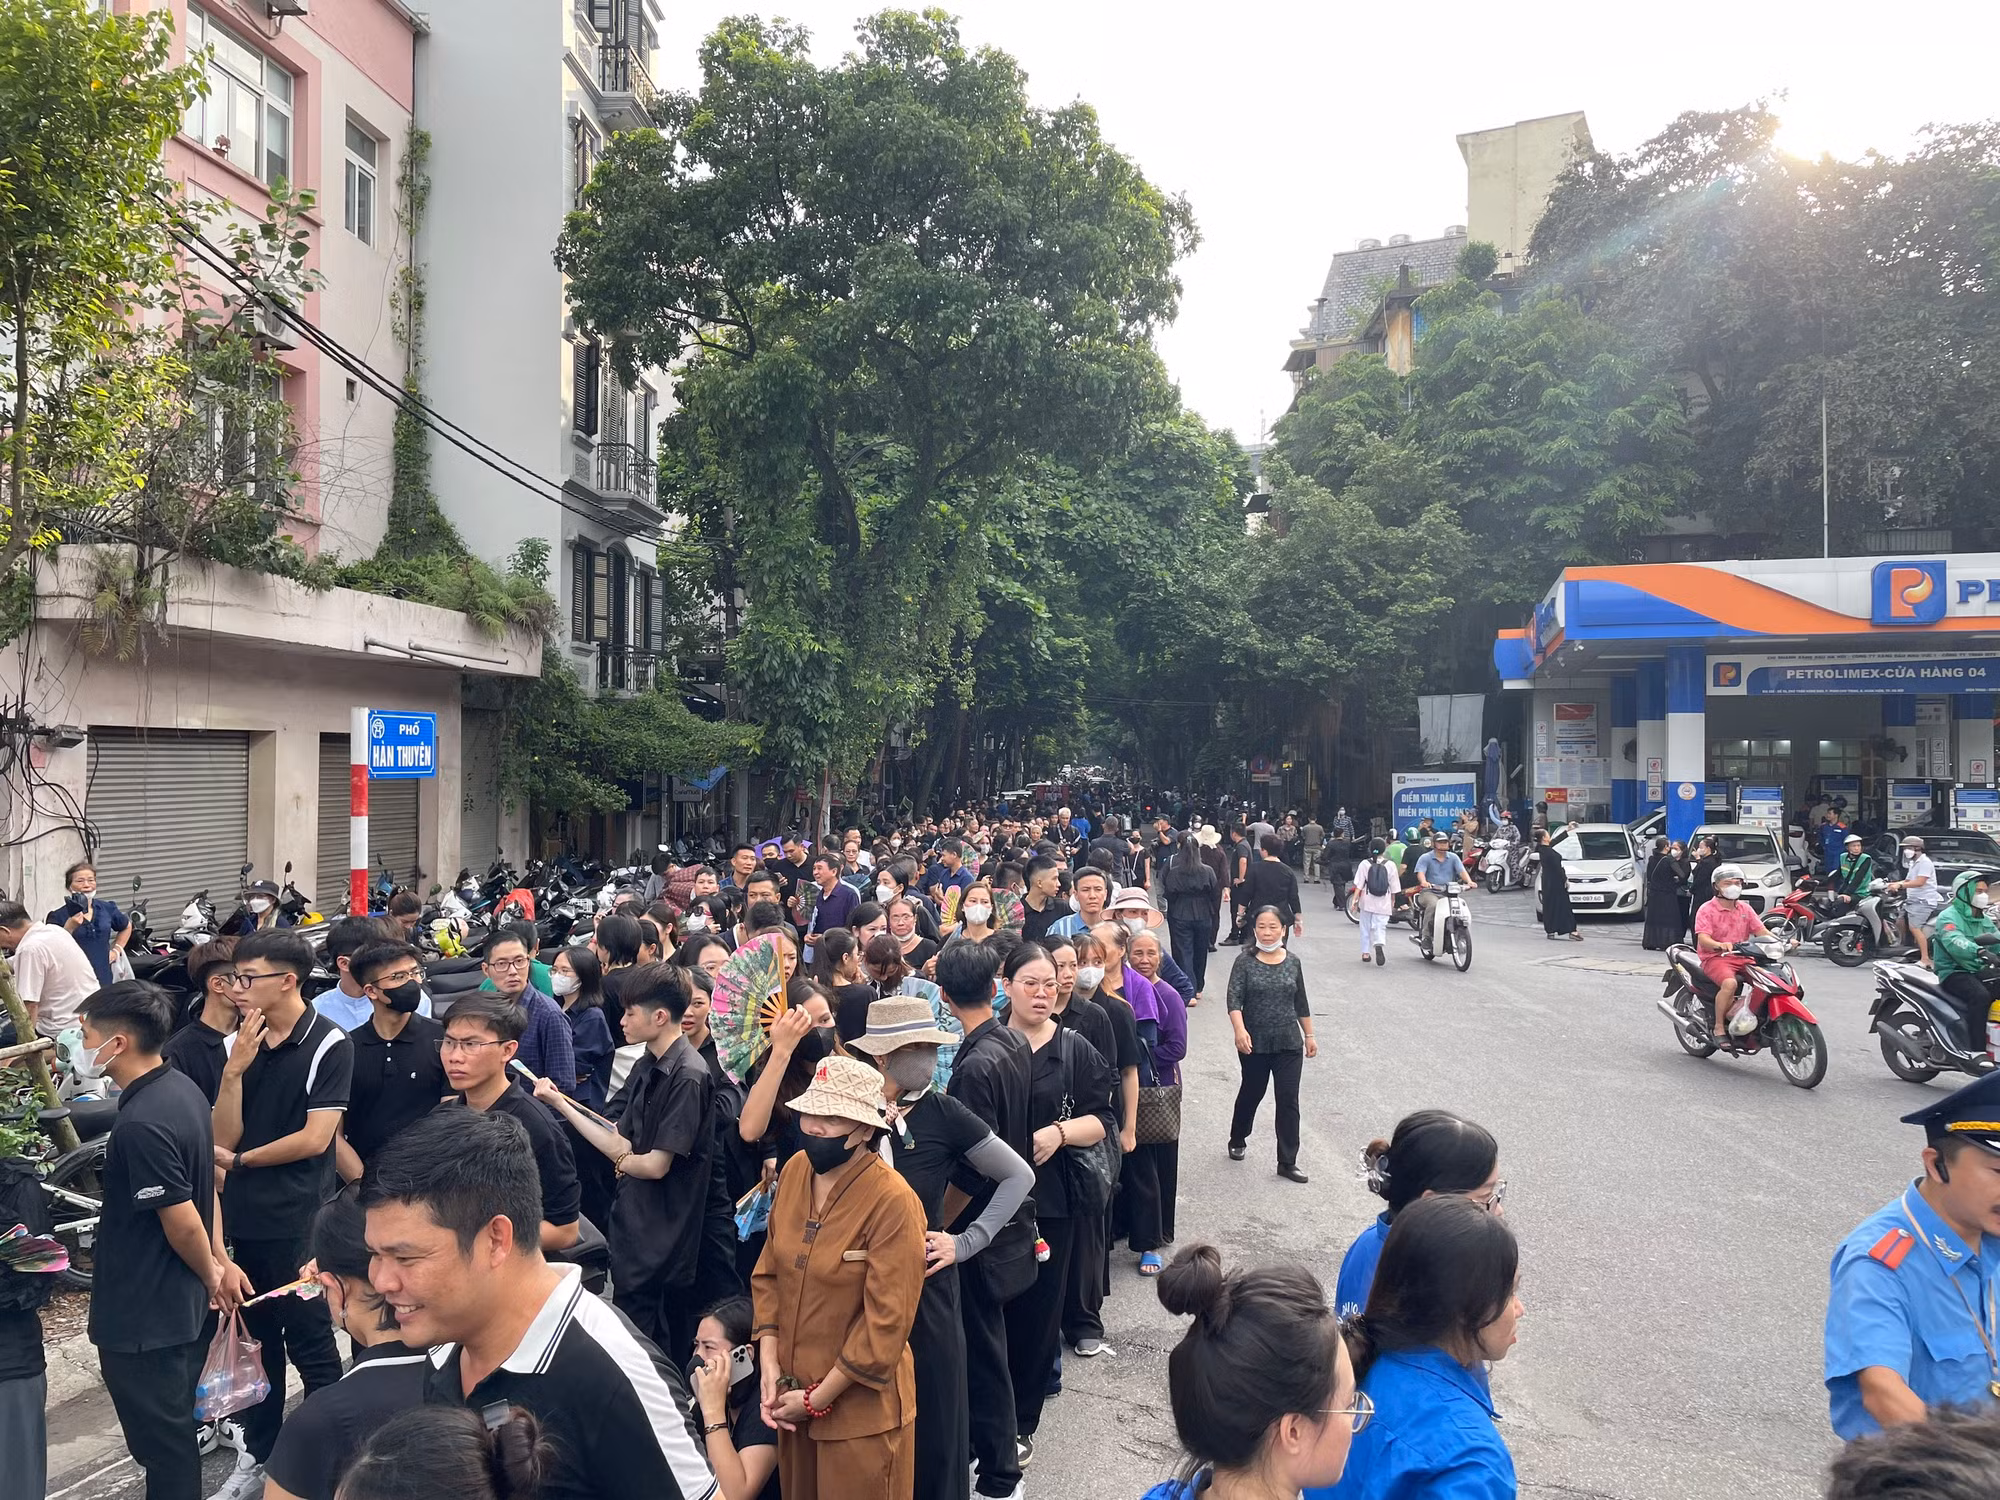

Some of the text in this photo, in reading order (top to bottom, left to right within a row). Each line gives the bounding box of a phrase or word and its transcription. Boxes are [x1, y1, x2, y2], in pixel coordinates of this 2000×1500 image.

[1920, 666, 1964, 678] HÀNG
[1968, 667, 1986, 678] 04
[399, 720, 420, 735] PHỐ
[373, 740, 431, 767] HÀN THUYÊN
[1421, 793, 1439, 803] THAY
[1456, 793, 1466, 803] XE
[1418, 806, 1431, 817] PHÍ
